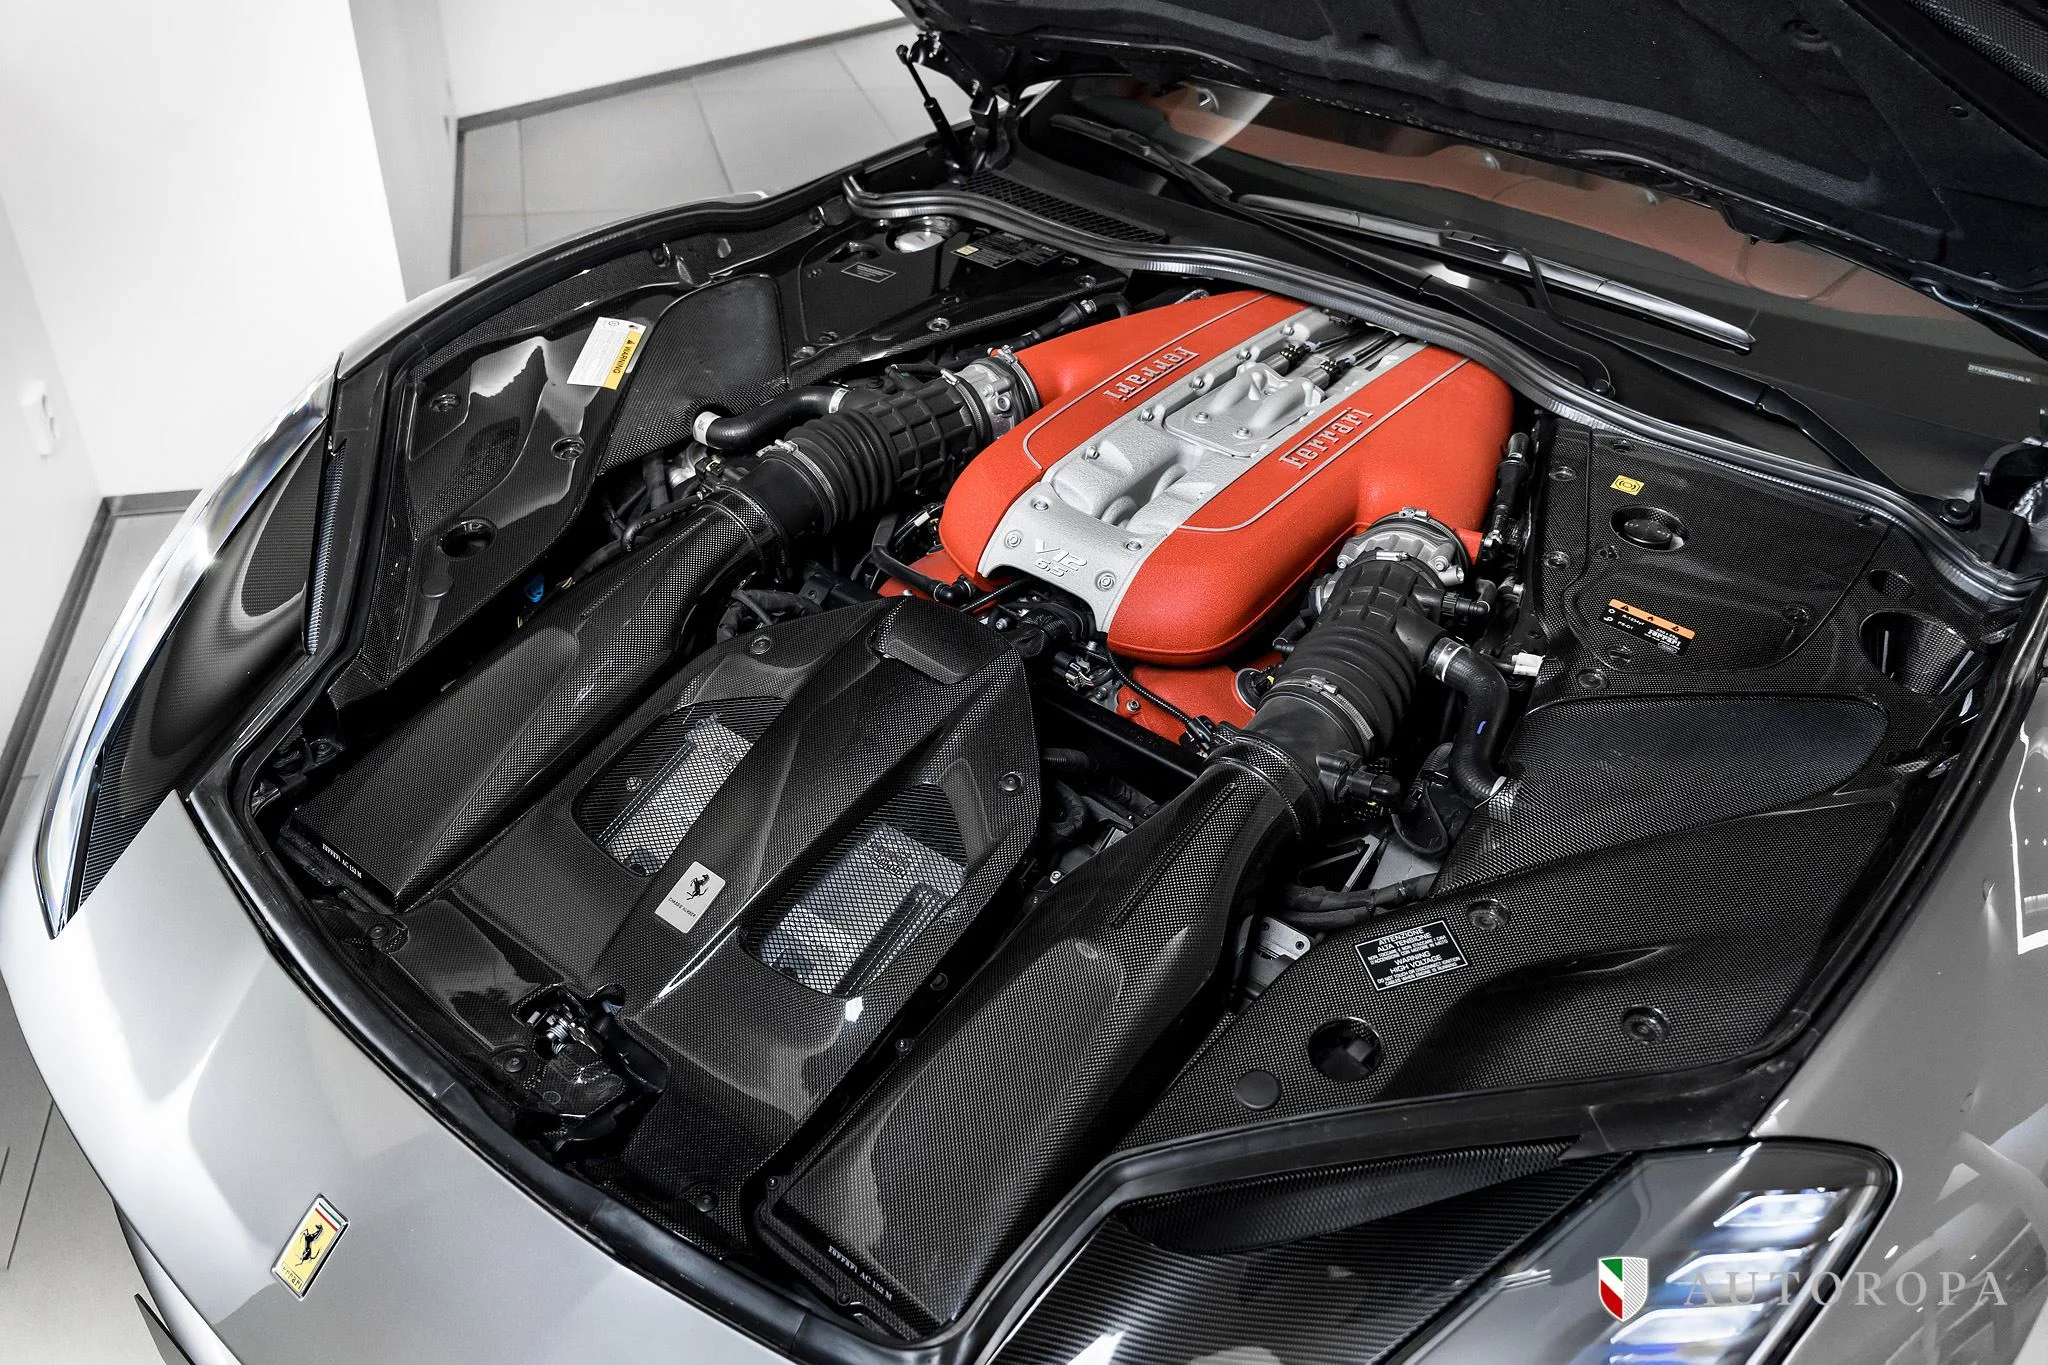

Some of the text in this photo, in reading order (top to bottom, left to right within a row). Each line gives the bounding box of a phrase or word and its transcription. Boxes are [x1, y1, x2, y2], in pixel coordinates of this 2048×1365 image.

[612, 345, 632, 374] WARNING
[1103, 346, 1200, 402] Ferrari
[1278, 407, 1374, 470] Ferrari
[1035, 538, 1088, 571] V12
[1034, 558, 1069, 577] 6.5
[1648, 629, 1681, 646] Ferrari
[1377, 932, 1432, 952] ALTA TENSIONE
[1378, 927, 1424, 946] ATTENZIONE
[1390, 954, 1442, 974] HIGH VOLTAGE
[1394, 950, 1431, 966] WARNING
[828, 1245, 893, 1301] Ferrari AC 152 M
